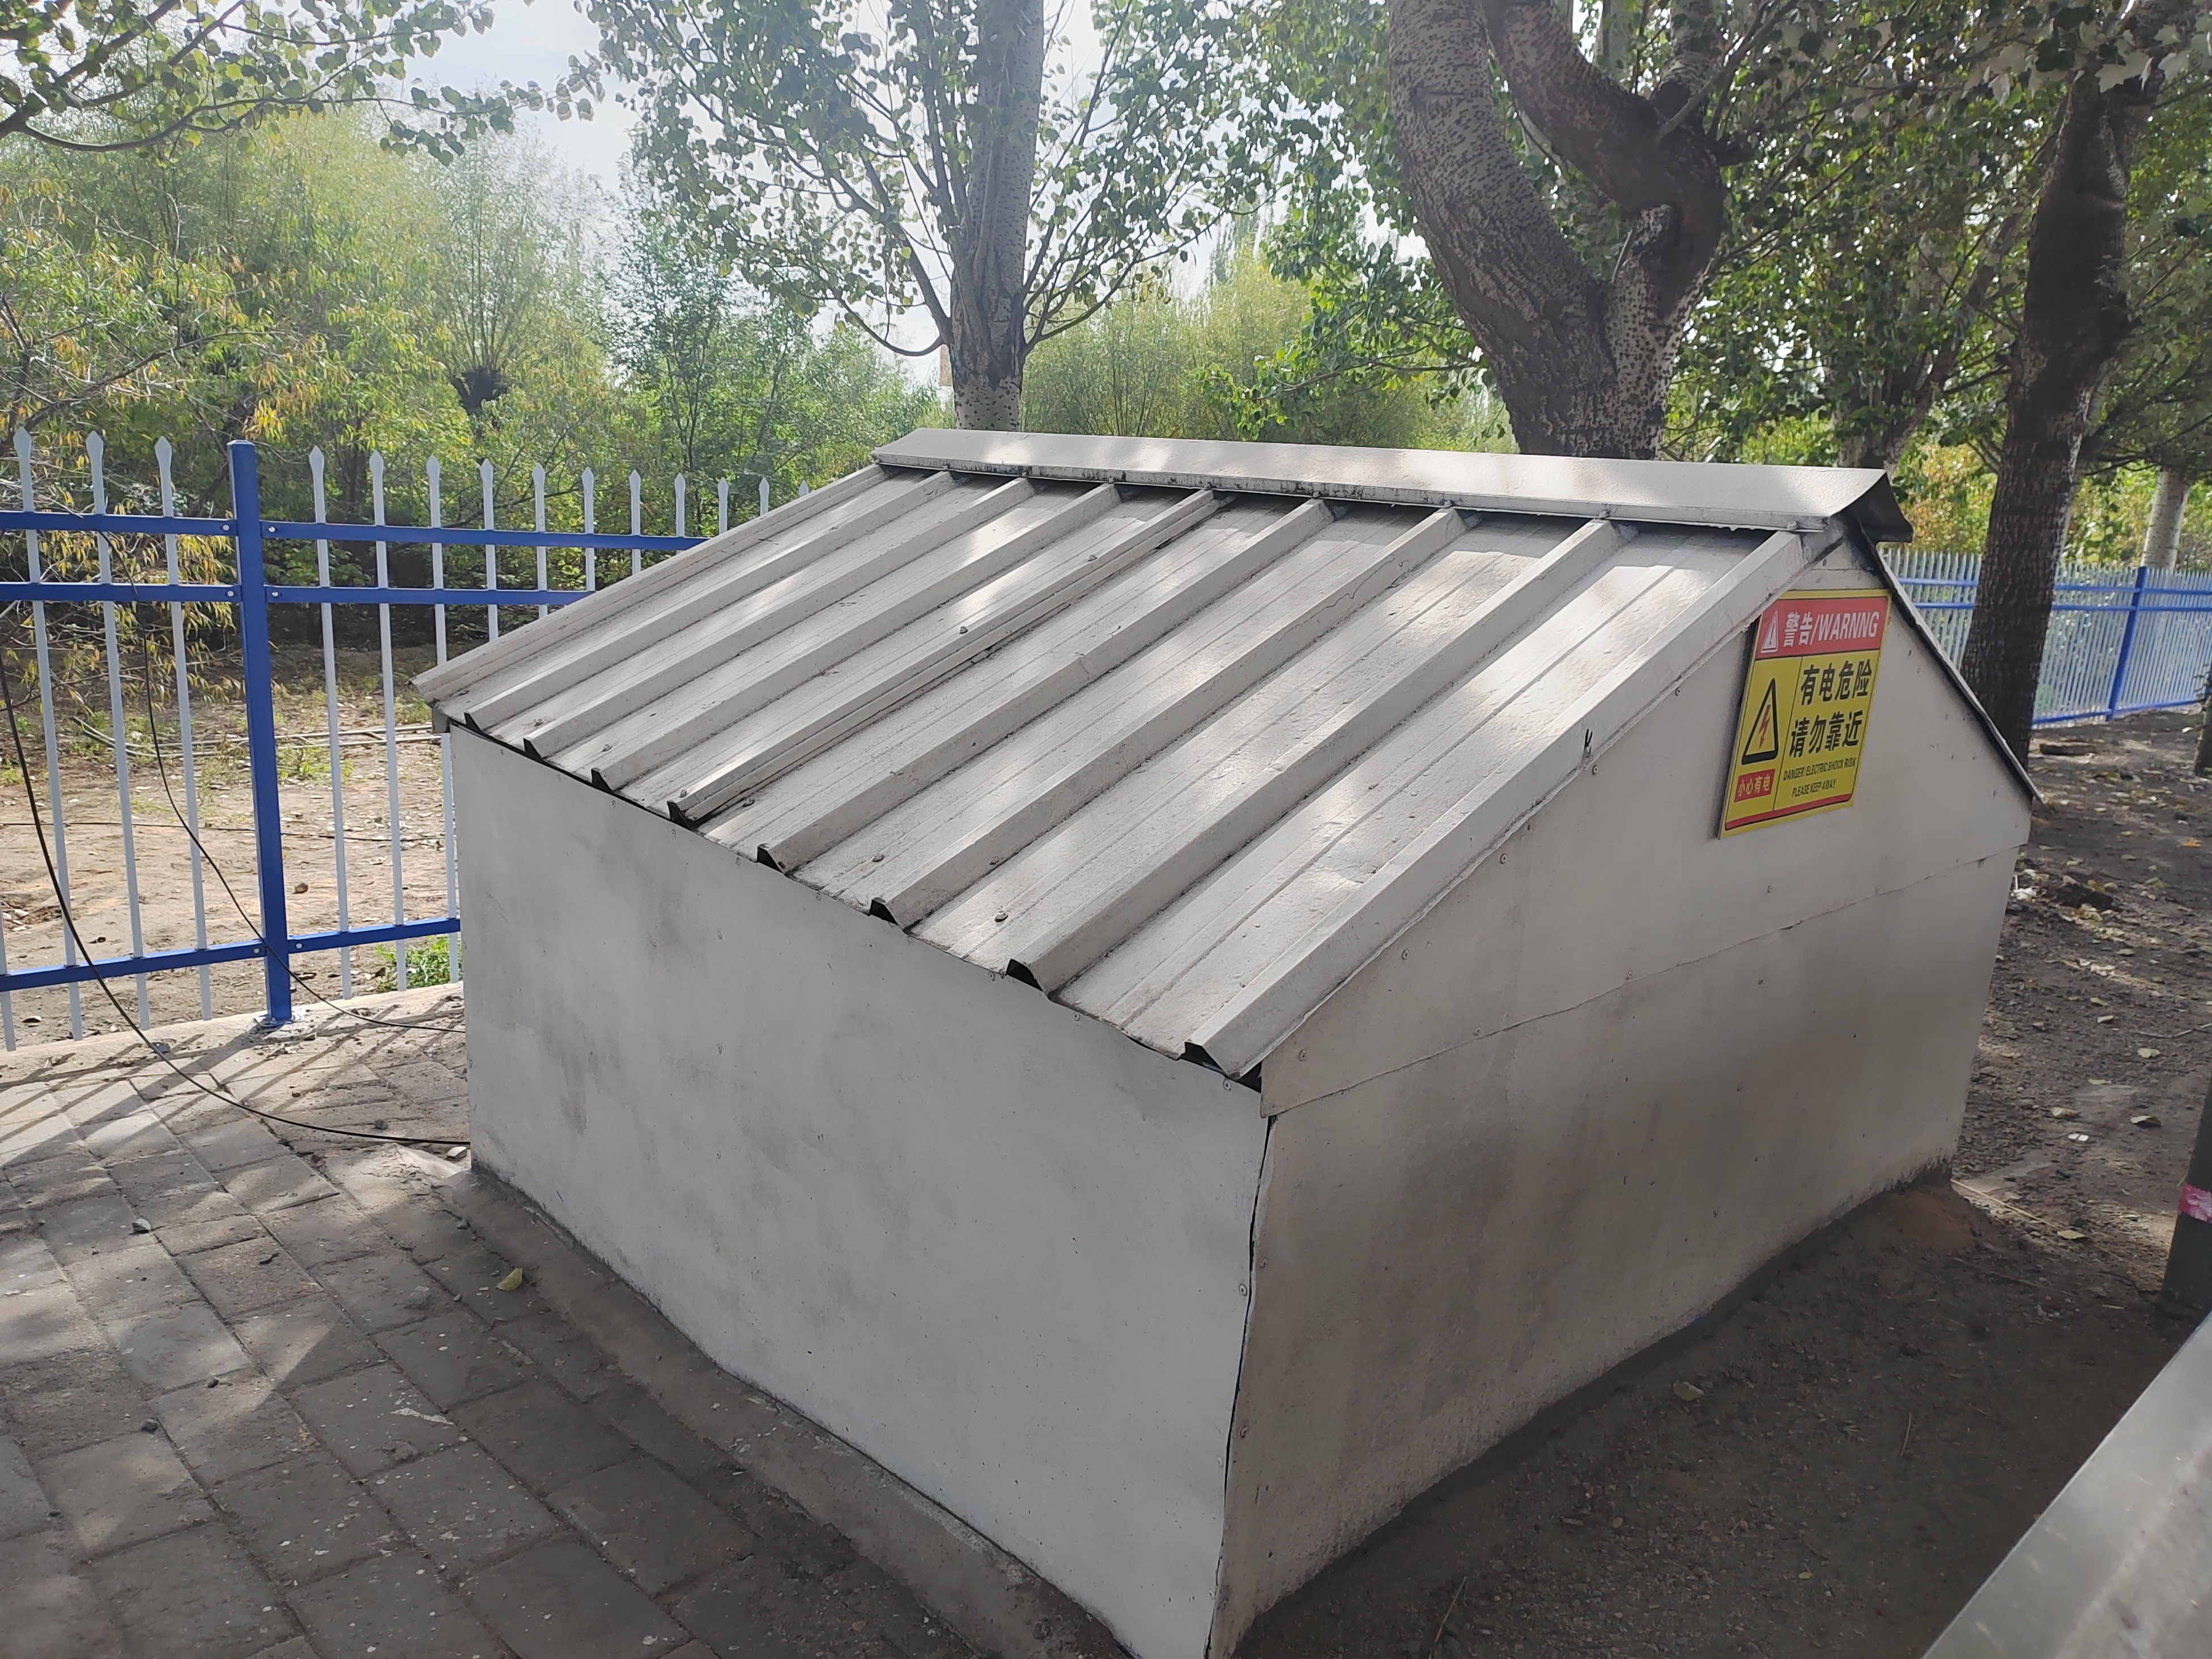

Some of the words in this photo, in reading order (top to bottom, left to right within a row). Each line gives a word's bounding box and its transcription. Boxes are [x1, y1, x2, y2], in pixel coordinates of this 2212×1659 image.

[1801, 658, 1872, 706] 有电危险
[1789, 709, 1863, 758] 请勿靠近
[1806, 763, 1828, 776] ELECTRIC
[1828, 759, 1845, 771] SHOCK
[1844, 757, 1856, 768] RISK
[1738, 773, 1770, 797] 小心有电
[1792, 784, 1810, 797] PLEASE
[1810, 781, 1822, 793] KEEP
[1822, 778, 1836, 790] AWAY
